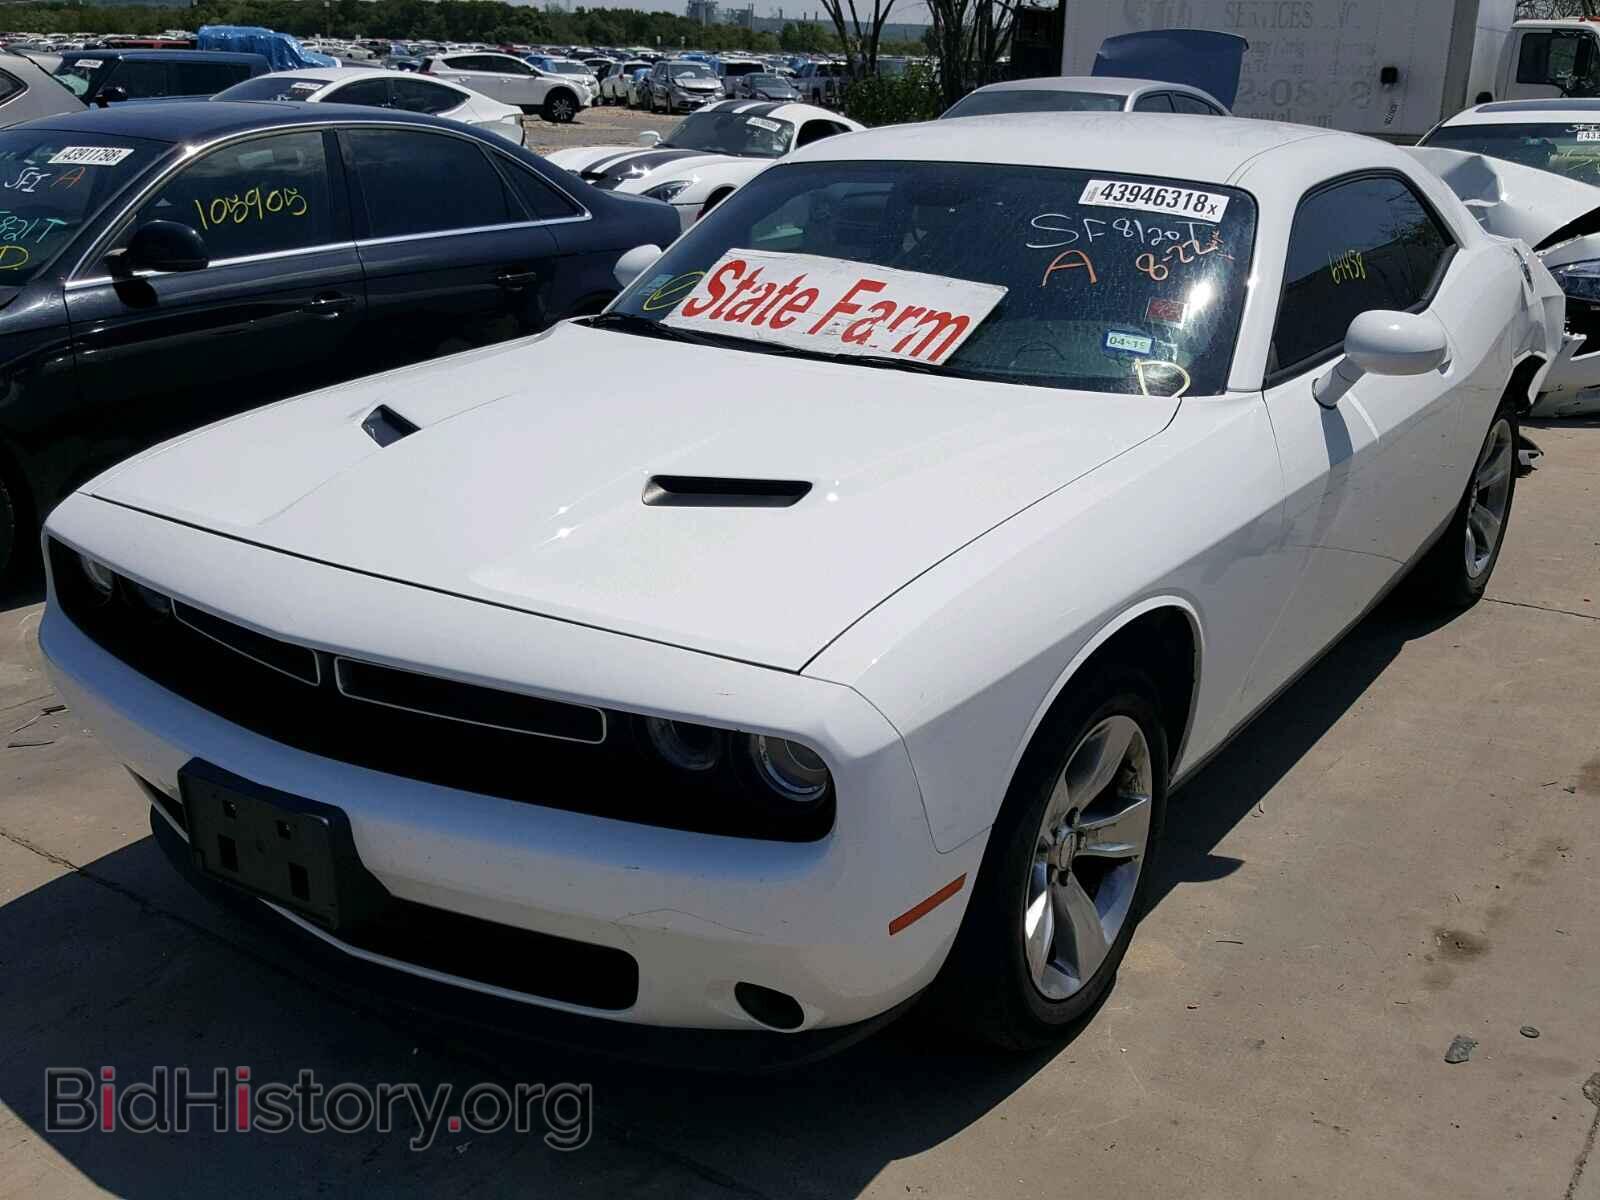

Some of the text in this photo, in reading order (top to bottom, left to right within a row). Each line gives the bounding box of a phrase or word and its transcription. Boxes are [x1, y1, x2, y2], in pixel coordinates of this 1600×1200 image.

[1041, 250, 1097, 287] A
[681, 260, 820, 327] State
[807, 278, 972, 363] Farm
